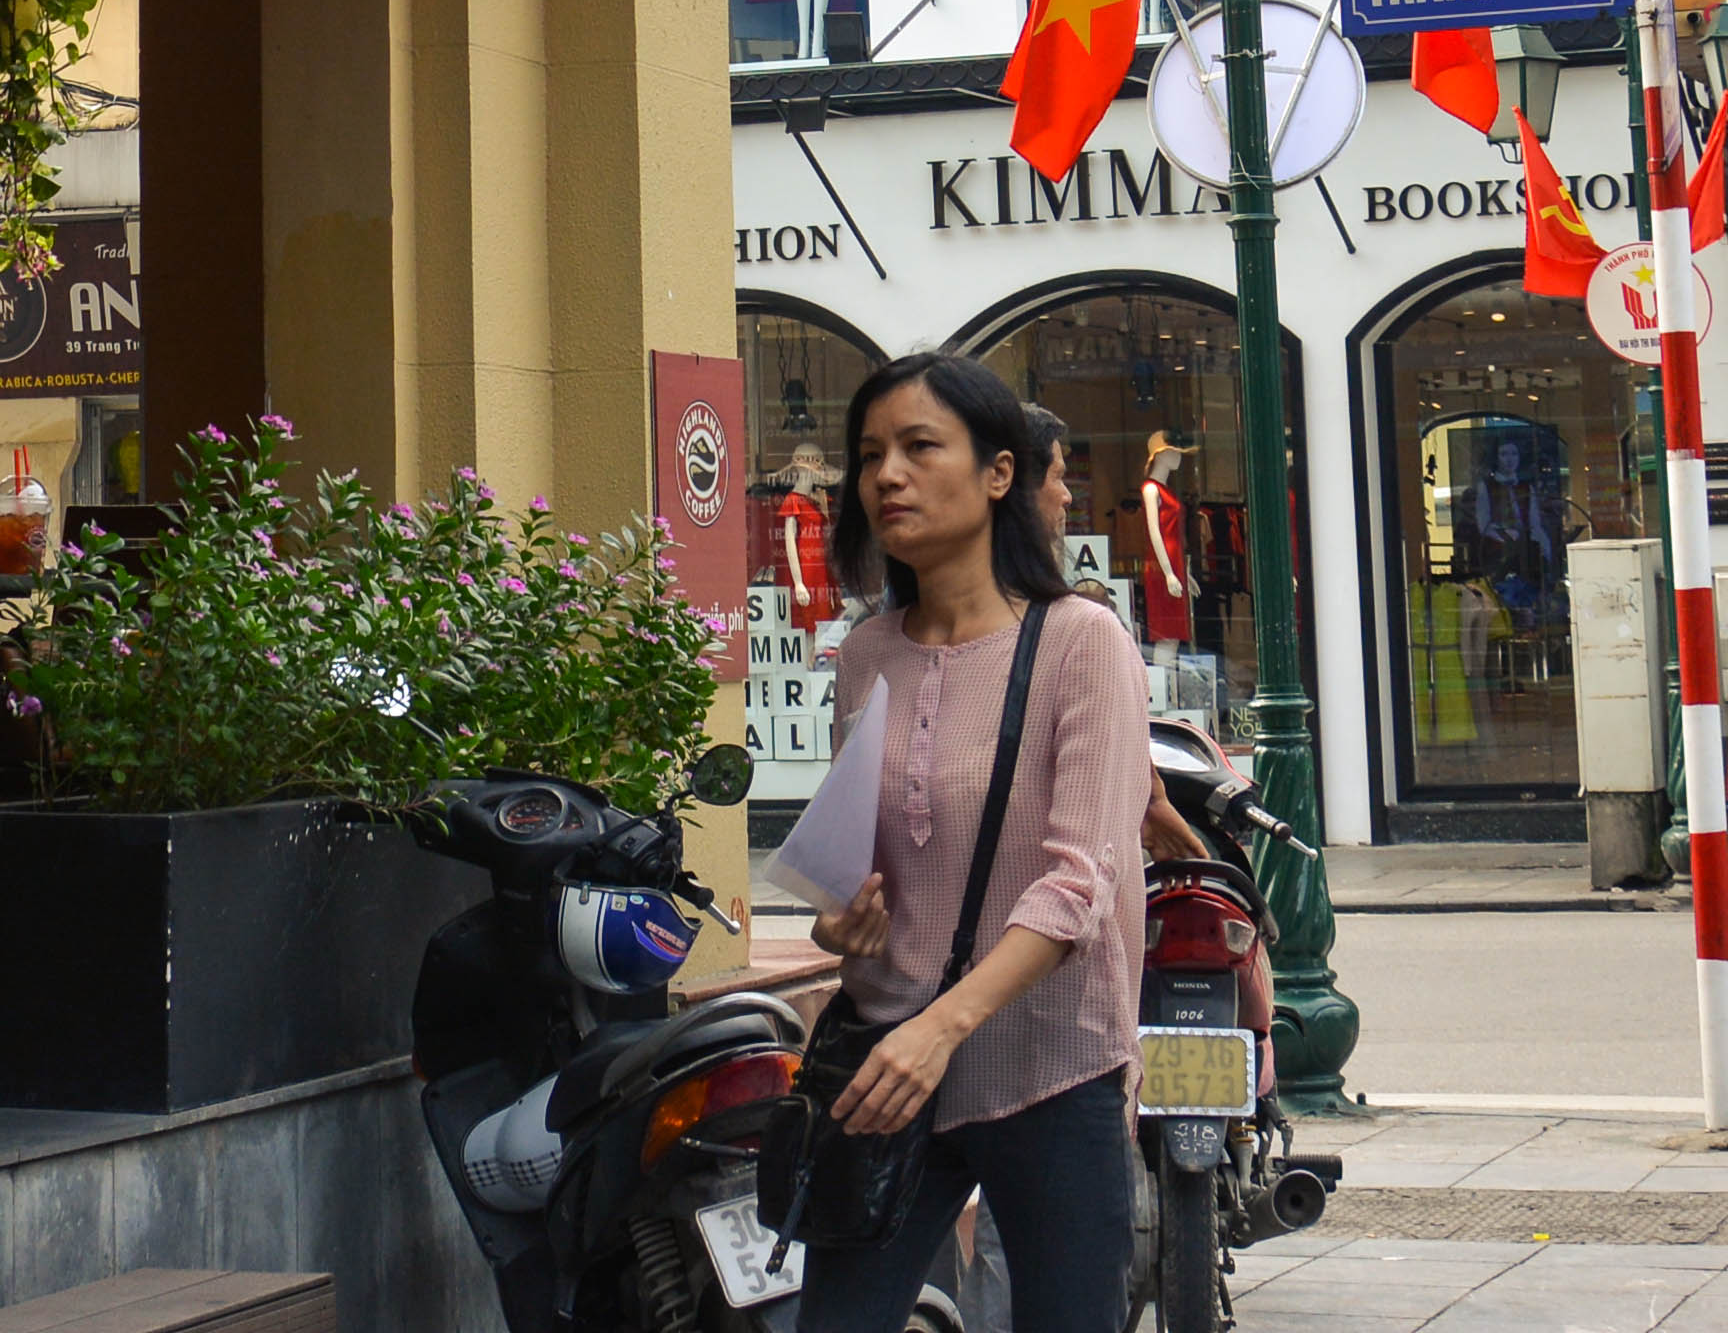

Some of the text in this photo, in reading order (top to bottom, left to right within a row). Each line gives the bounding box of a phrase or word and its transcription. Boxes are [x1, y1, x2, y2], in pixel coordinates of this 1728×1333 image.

[734, 223, 841, 263] HION
[69, 279, 141, 332] AN
[66, 339, 121, 354] 39 Trang
[679, 408, 726, 461] HIGHLANDS
[685, 490, 723, 520] COFFEE
[1174, 982, 1211, 990] HONDA
[1176, 1009, 1205, 1021] 1006
[720, 1202, 770, 1250] 30
